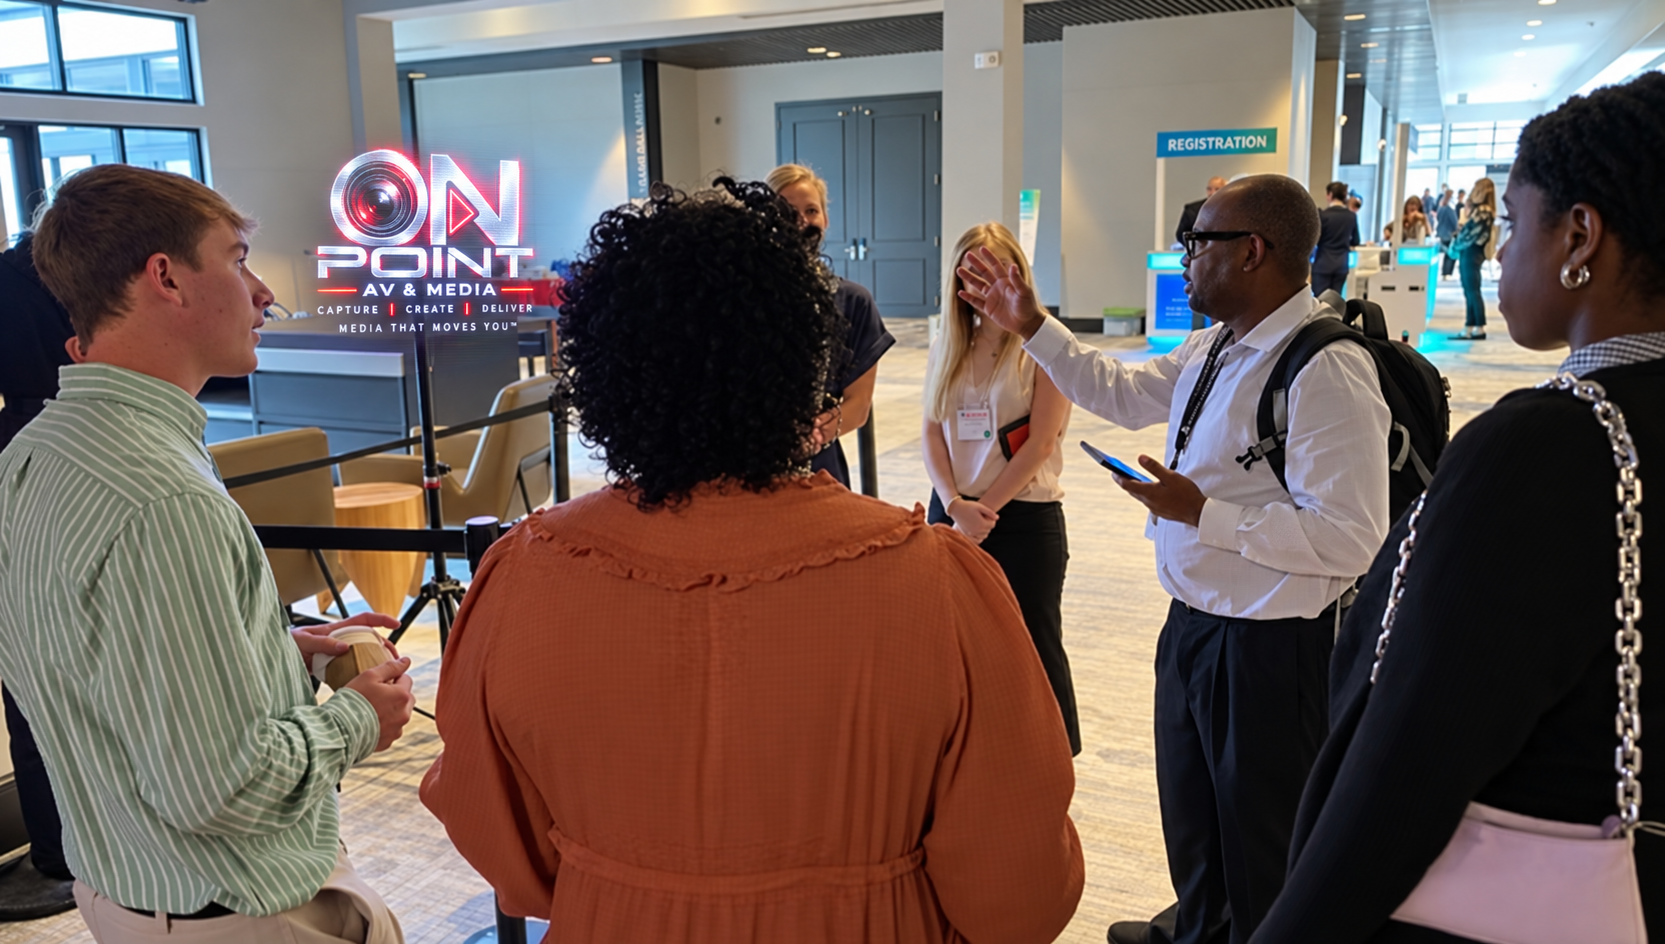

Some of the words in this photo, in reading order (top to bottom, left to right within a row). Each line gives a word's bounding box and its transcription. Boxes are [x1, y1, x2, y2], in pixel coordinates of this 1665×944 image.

[1168, 135, 1267, 151] REGISTRATION
[330, 149, 520, 246] ON
[317, 246, 533, 278] POINT
[362, 284, 395, 296] AV
[403, 284, 416, 296] &
[427, 283, 497, 296] MEDIA
[317, 305, 379, 315] CAPTURE
[405, 304, 454, 314] CREATE
[482, 304, 533, 313] DELIVER
[339, 323, 383, 333] MEDIA
[391, 323, 424, 332] THAT
[432, 322, 477, 331] MOVES
